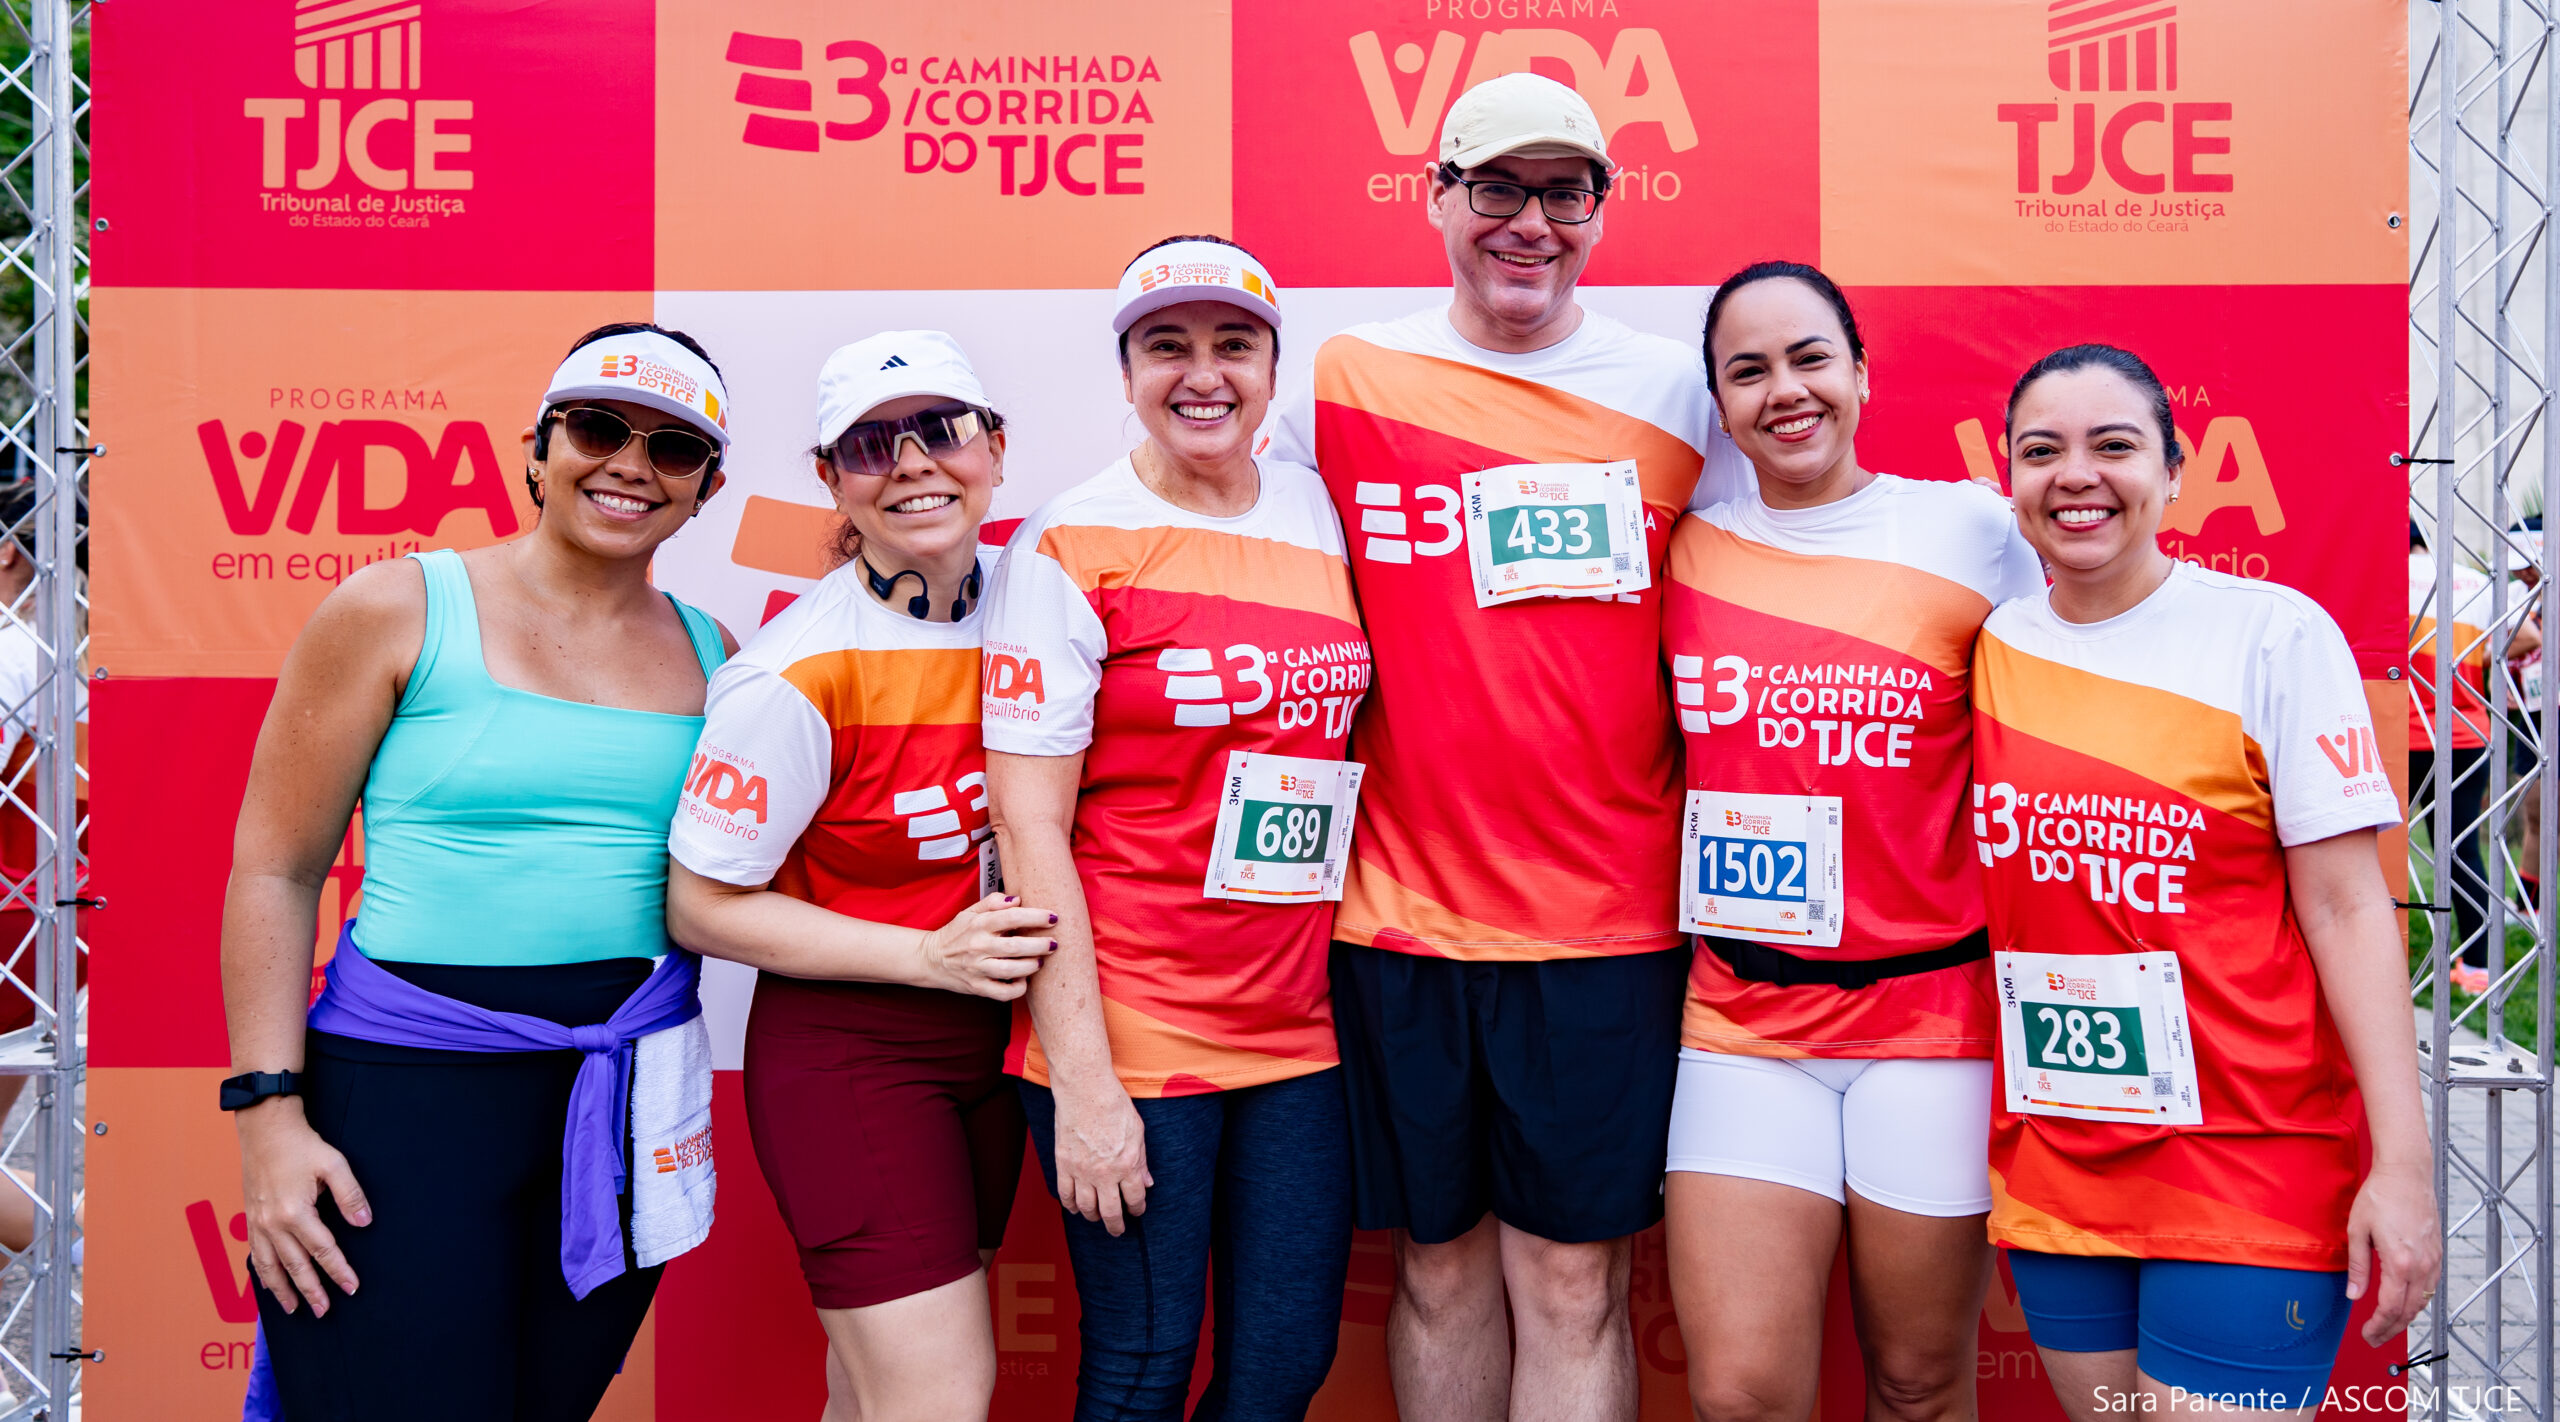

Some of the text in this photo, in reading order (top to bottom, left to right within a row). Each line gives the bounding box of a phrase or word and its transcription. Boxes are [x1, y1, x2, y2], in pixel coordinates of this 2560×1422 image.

[1427, 0, 1620, 20] PROGRAMA
[920, 55, 1162, 83] CAMINHADA
[903, 89, 1154, 126] /CORRIDA
[244, 98, 473, 191] TJCE
[1998, 101, 2234, 195] TJCE
[905, 131, 1145, 196] DO TJCE
[260, 193, 466, 218] Tribunal de Justiça
[2015, 199, 2226, 221] Tribunal de Justiça
[289, 213, 430, 228] do Estado do Ceará
[2045, 218, 2190, 233] do Estado do Ceará
[1176, 262, 1231, 271] CAMINHADA
[640, 366, 697, 395] /CORRIDA
[646, 360, 699, 389] CAMINHADA
[270, 388, 447, 410] PROGRAMA
[197, 419, 519, 538] VIDA
[1471, 494, 1483, 520] 3KM
[1507, 508, 1593, 556] 433
[212, 553, 272, 580] em
[1283, 641, 1371, 668] CAMINHA
[1768, 664, 1933, 691] CAMINHADA
[1277, 697, 1318, 730] DO
[1756, 686, 1924, 720] /CORRIDA
[1757, 716, 1916, 768] DO TJCE
[1229, 776, 1242, 806] 3KM
[2343, 781, 2371, 797] em
[689, 803, 759, 841] equilíbrio
[1690, 812, 1699, 839] 5KM
[2034, 792, 2207, 831] CAMINHADA
[1256, 806, 1321, 859] 689
[1752, 825, 1771, 835] TJCE
[2026, 816, 2196, 861] /CORRIDA
[988, 859, 996, 888] 5KM
[1702, 840, 1804, 897] 1502
[2029, 849, 2187, 914] DO TJCE
[2003, 977, 2016, 1008] 3KM
[2076, 989, 2097, 1000] TJCE
[2037, 1007, 2127, 1069] 283
